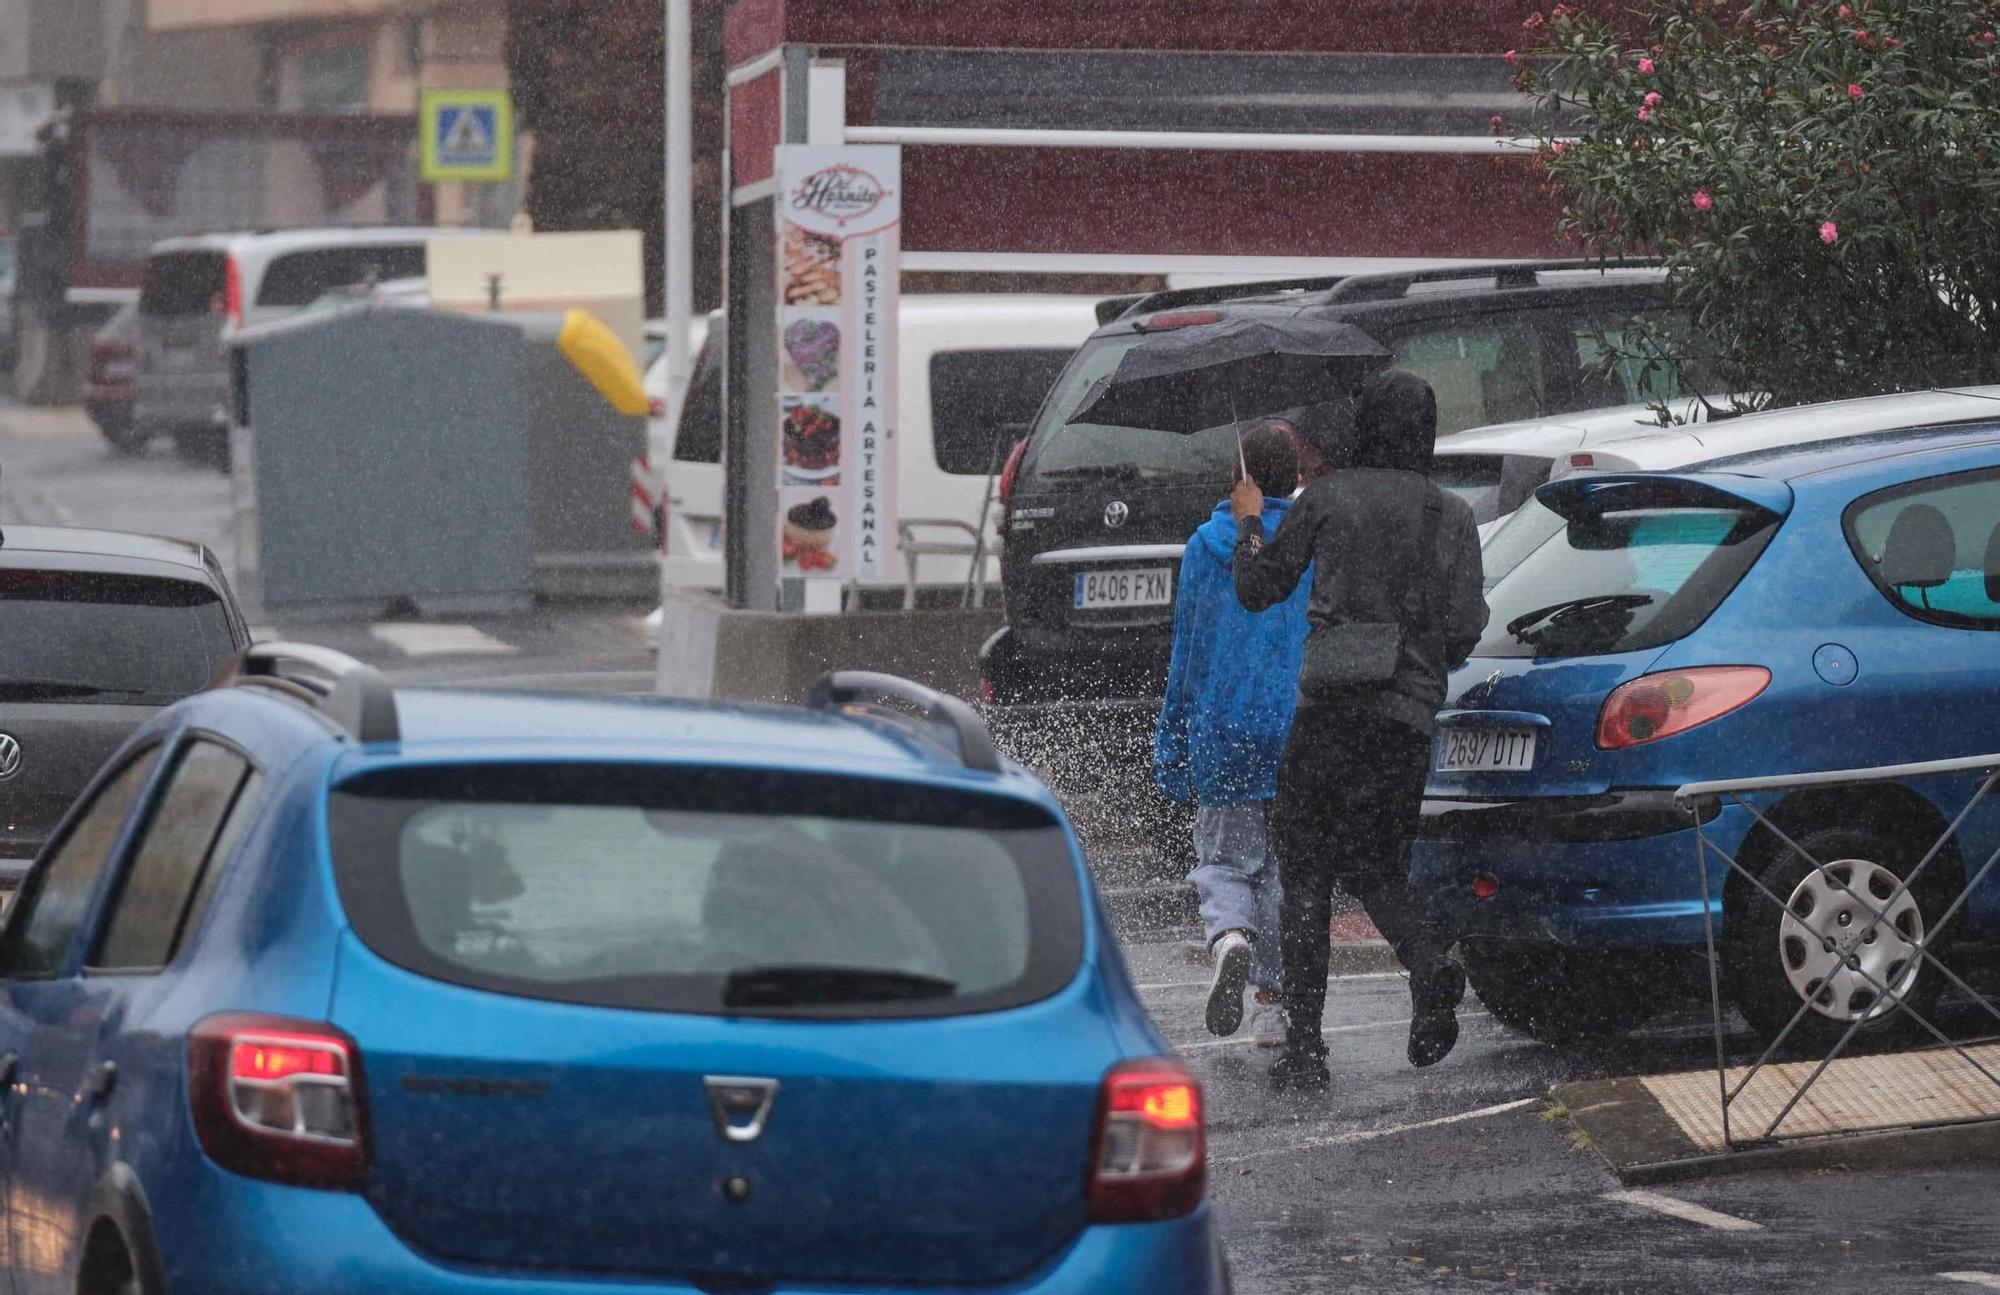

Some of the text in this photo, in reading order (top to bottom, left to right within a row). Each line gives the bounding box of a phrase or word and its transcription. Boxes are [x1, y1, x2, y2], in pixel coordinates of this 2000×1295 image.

[862, 421, 876, 563] ARTESANAL
[1087, 572, 1168, 601] 8406 FXN
[1446, 731, 1531, 767] 2697 DTT
